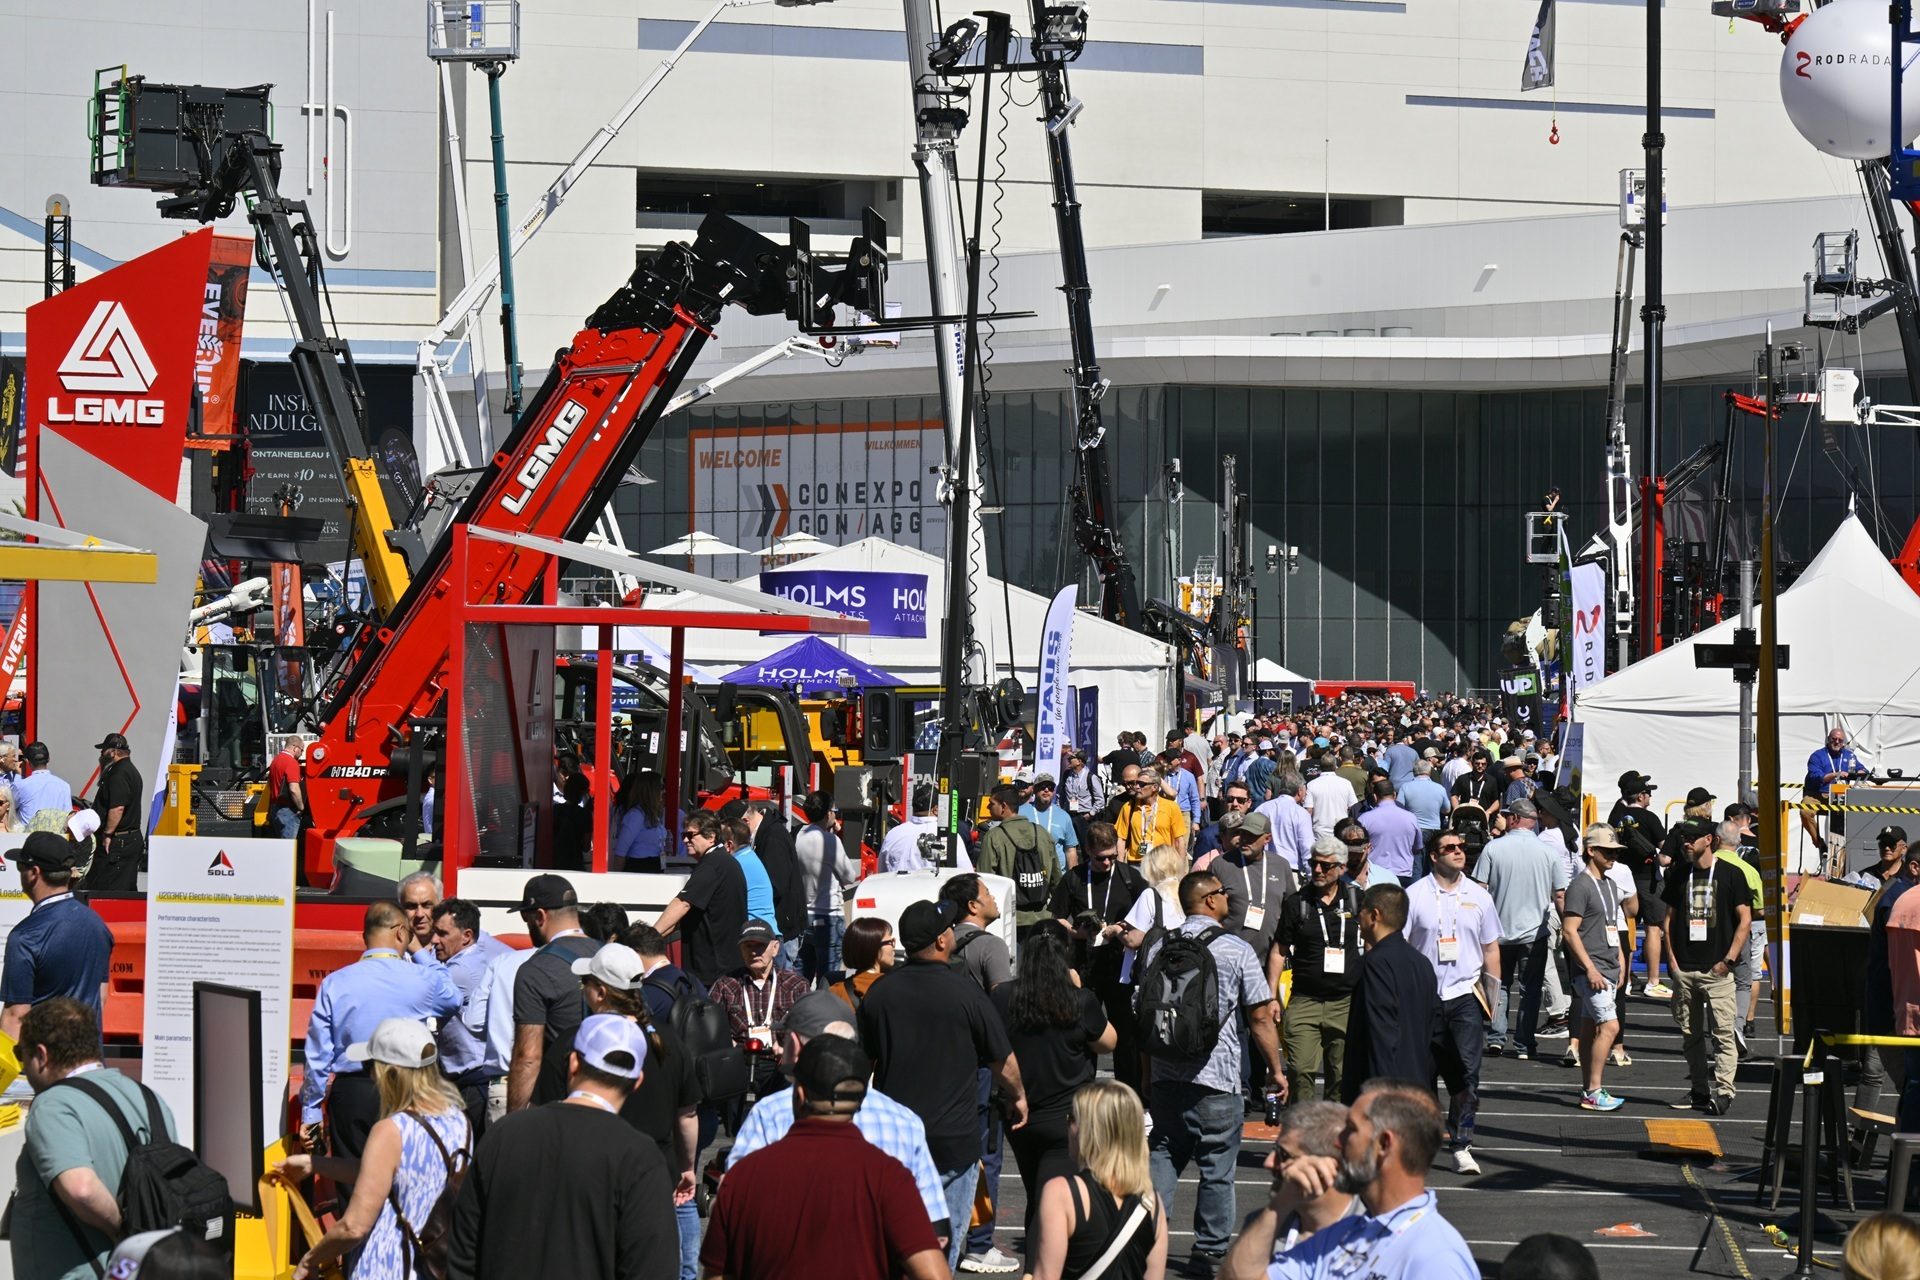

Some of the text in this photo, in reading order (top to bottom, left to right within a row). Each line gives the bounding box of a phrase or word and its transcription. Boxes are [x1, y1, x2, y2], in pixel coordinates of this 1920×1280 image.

[1815, 54, 1891, 66] RODRADA
[48, 397, 165, 425] LGMG
[250, 413, 322, 432] NDULG
[864, 440, 921, 451] WILLKOMMEN
[251, 450, 324, 459] ONTAINEBLEAU
[500, 399, 587, 515] LGMG
[699, 449, 782, 469] WELCOME
[798, 480, 921, 505] CONEXPO
[775, 584, 866, 608] HOLMS
[2, 606, 27, 675] EVERU
[758, 667, 850, 679] HOLMS
[1040, 630, 1061, 735] PAUS
[330, 766, 371, 778] H1840
[207, 869, 235, 877] SDLG
[189, 892, 213, 901] Electric
[214, 892, 233, 902] Utility
[233, 893, 255, 901] Terrain
[256, 894, 279, 903] Vehicle
[158, 914, 220, 923] Performance characteristics
[154, 1034, 192, 1043] Main parameters
